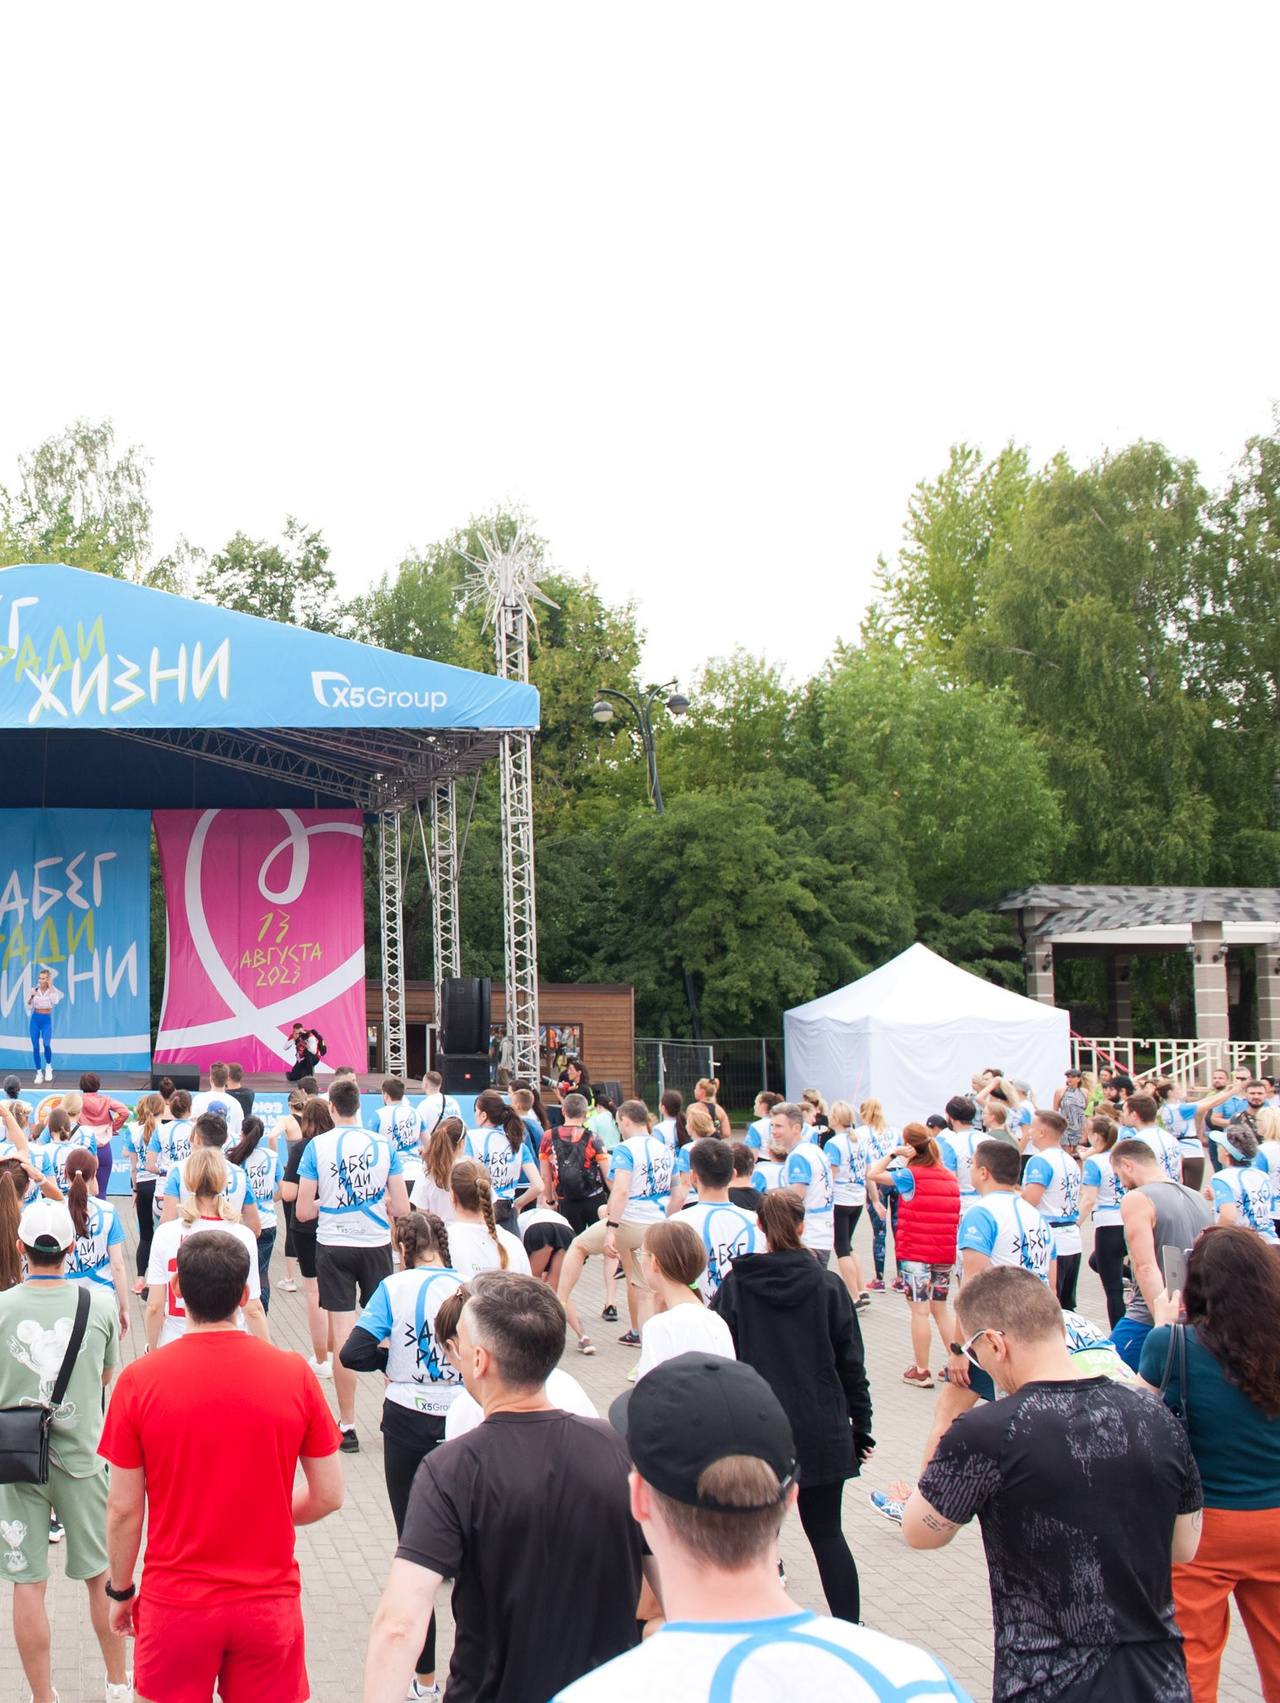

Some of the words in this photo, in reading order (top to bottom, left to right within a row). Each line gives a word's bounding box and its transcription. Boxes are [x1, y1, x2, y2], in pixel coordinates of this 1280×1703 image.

[23, 636, 230, 724] ЖИЗНИ
[332, 686, 448, 713] X5Group
[257, 909, 291, 943] 13
[239, 941, 322, 969] АВГУСТА
[256, 963, 301, 987] 2023
[330, 1153, 372, 1178] ЗАБЕГ
[338, 1173, 370, 1190] РАДИ
[708, 1242, 746, 1269] АБЕГ
[421, 1402, 451, 1412] X5Gro
